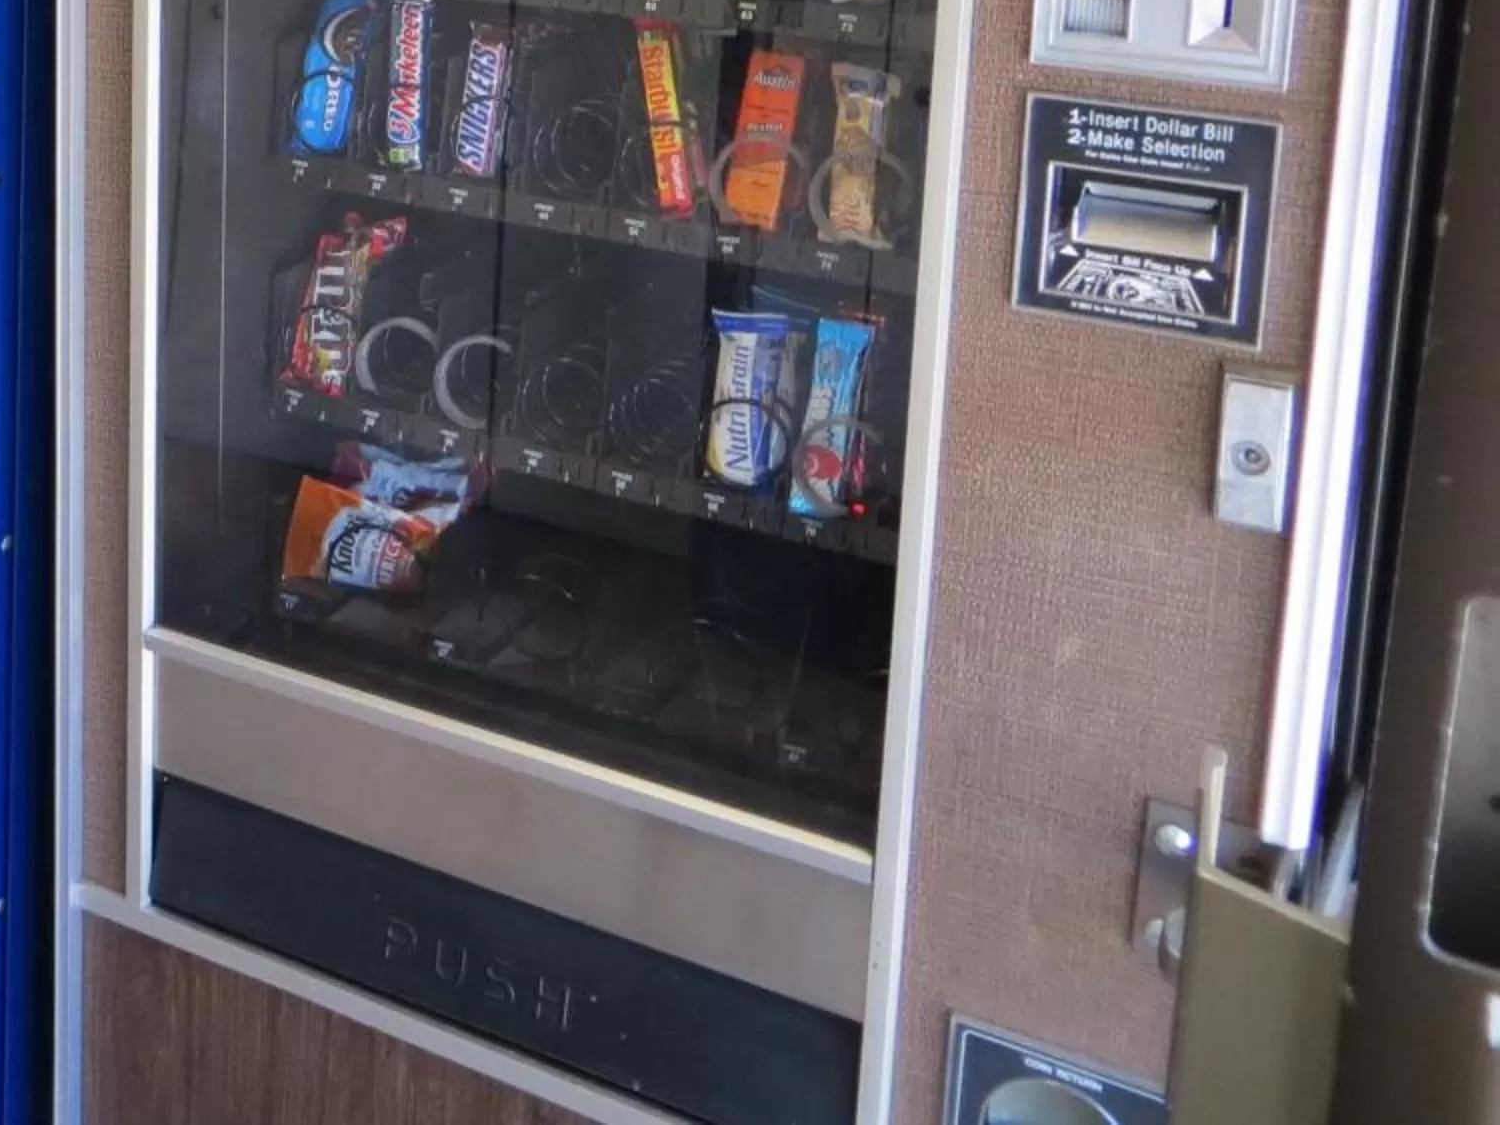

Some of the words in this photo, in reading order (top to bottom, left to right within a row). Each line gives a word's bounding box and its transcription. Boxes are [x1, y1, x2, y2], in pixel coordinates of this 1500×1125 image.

[457, 39, 500, 169] SNICKERS
[1068, 107, 1141, 133] 1-Insert
[1145, 115, 1199, 138] Dollar
[1203, 122, 1235, 143] Bill
[1067, 128, 1136, 151] 2-Make
[1141, 136, 1226, 163] Selection
[1085, 248, 1120, 264] Insert
[383, 915, 571, 1031] PUSH
